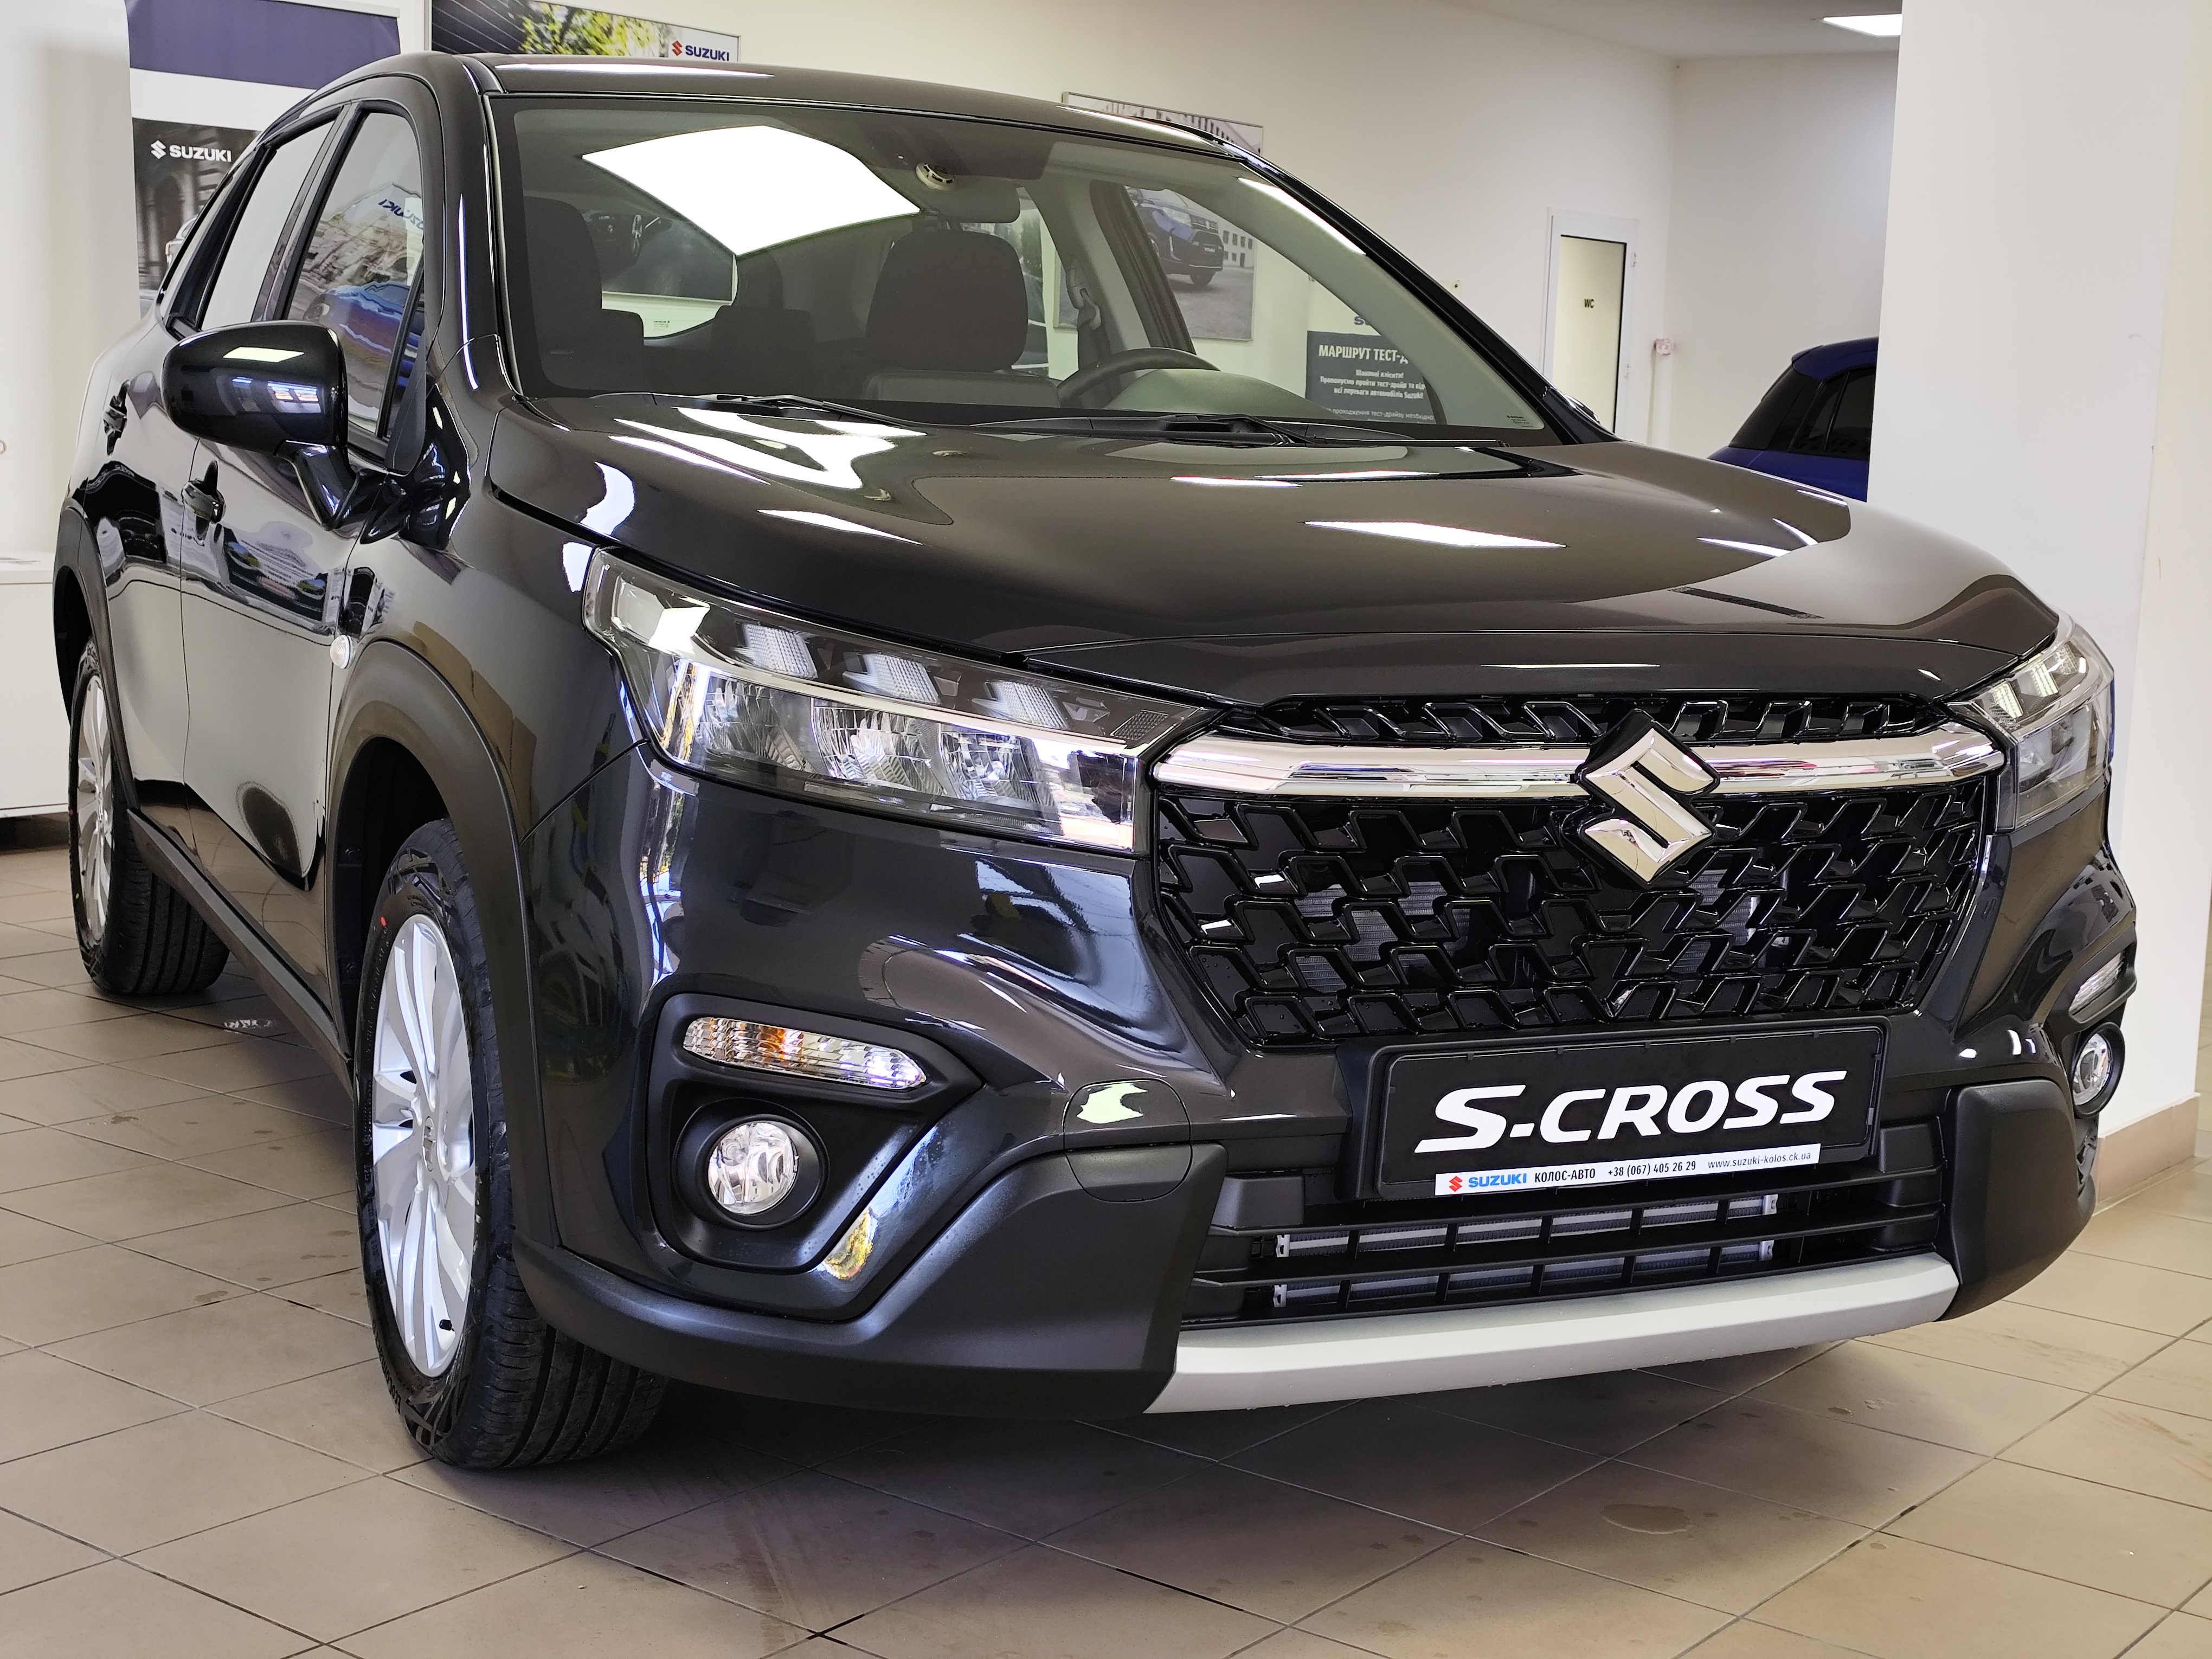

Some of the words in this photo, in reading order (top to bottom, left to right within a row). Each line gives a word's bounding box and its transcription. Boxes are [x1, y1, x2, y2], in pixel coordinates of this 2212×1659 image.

[685, 45, 729, 61] SUZUKI
[169, 145, 232, 162] SUZUKI
[1584, 298, 1594, 308] WC
[1319, 344, 1371, 360] МАРШРУТ
[1373, 349, 1409, 364] ТЕСТ-Д
[1414, 1070, 1847, 1153] S-CROSS
[1469, 1173, 1527, 1187] SUZUKI
[1535, 1168, 1596, 1182] КОЛОС-АВТО
[1608, 1166, 1624, 1176] +38
[1627, 1163, 1651, 1177] (067)
[1654, 1163, 1669, 1173] 405
[1673, 1162, 1683, 1172] 26
[1686, 1161, 1696, 1171] 29
[1708, 1152, 1811, 1168] www.suzuki-kolos.ck.ua
